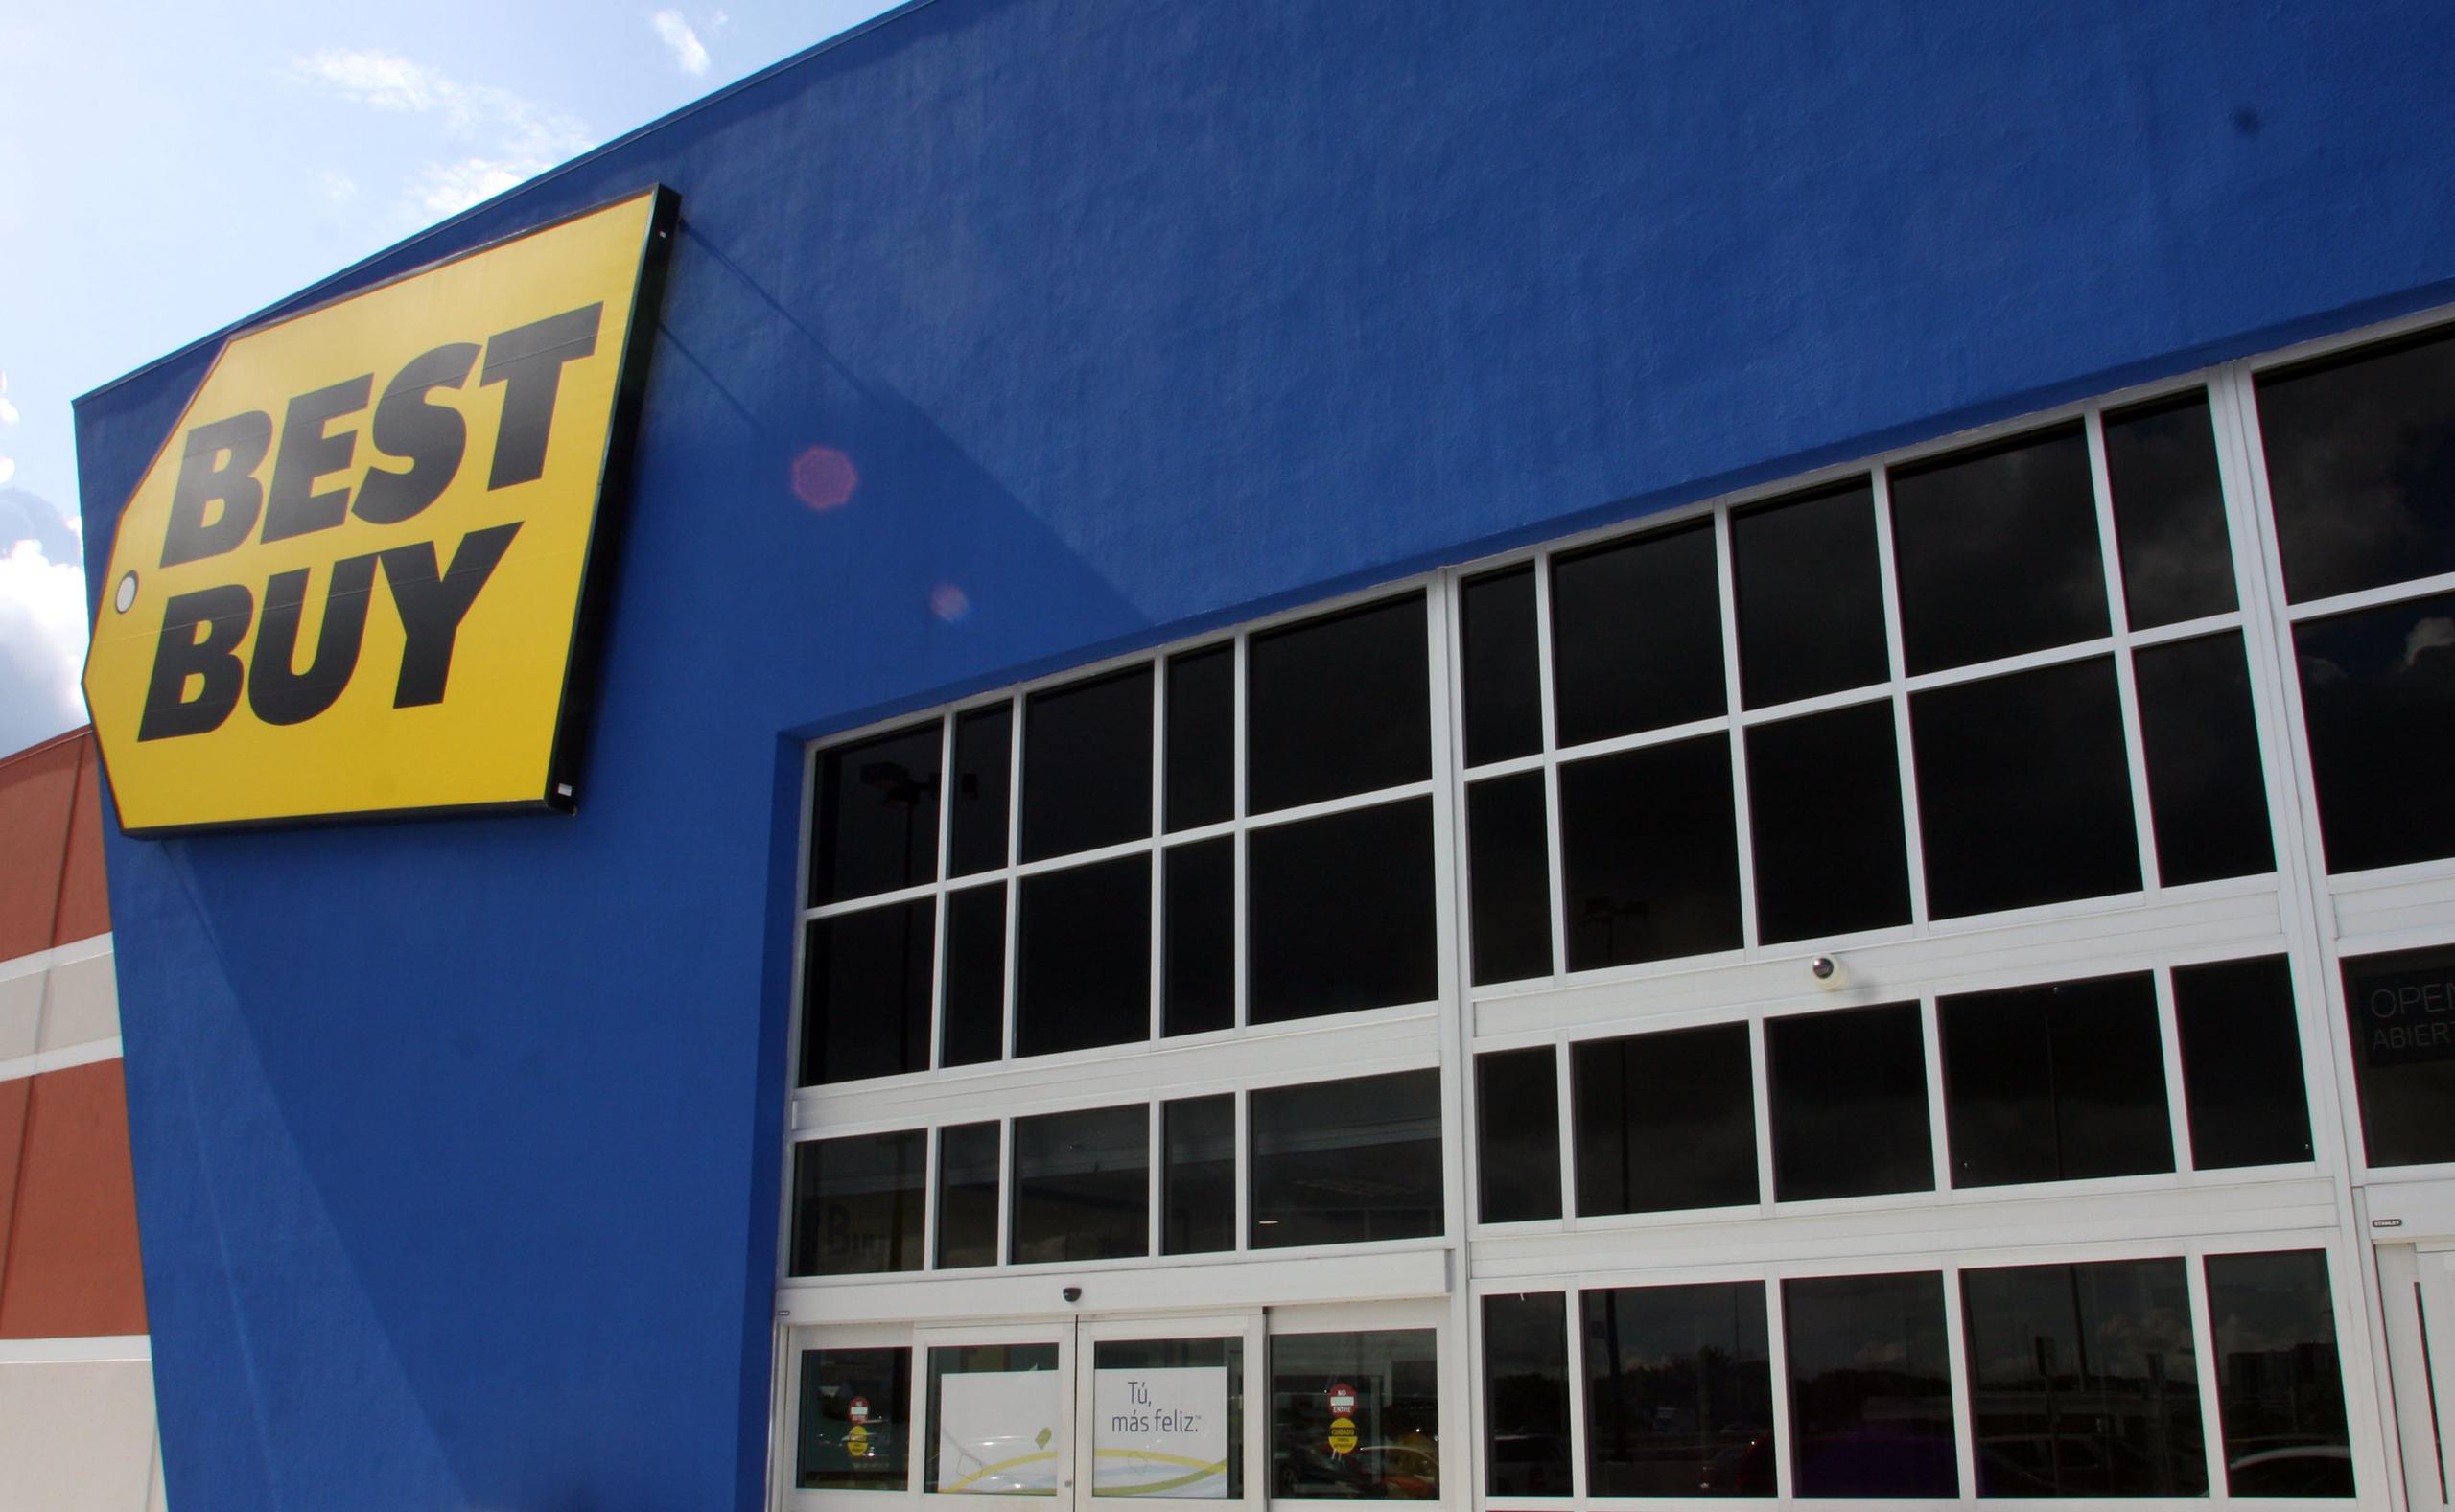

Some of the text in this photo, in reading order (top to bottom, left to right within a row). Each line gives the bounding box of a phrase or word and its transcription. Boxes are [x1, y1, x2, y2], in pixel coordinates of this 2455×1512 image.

[159, 300, 604, 569] BEST
[137, 520, 525, 742] BUY
[1111, 1409, 1150, 1432] más
[1128, 1381, 1152, 1407] Tú,
